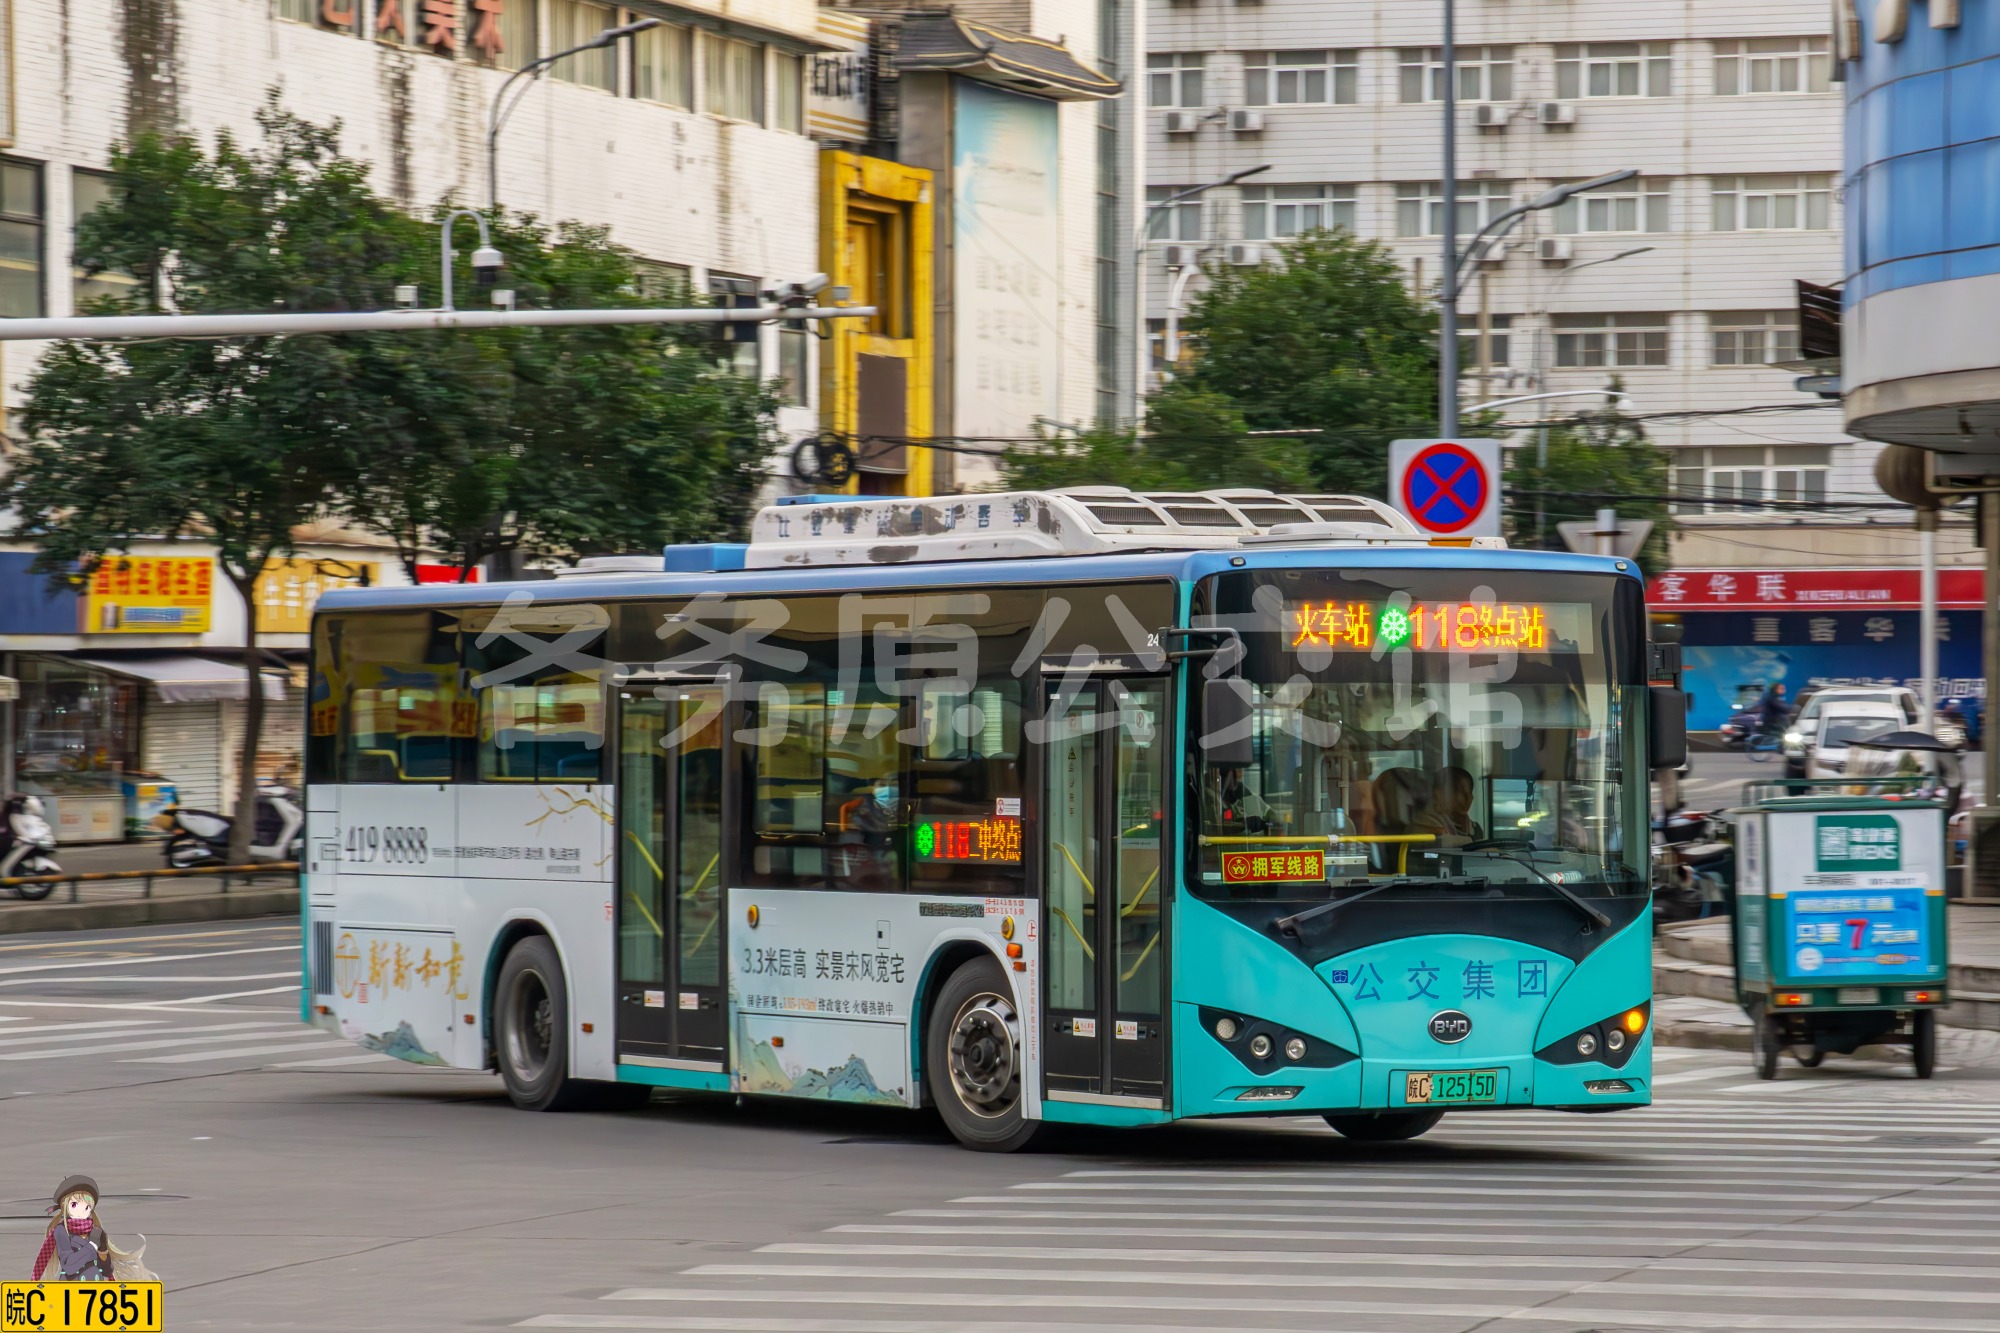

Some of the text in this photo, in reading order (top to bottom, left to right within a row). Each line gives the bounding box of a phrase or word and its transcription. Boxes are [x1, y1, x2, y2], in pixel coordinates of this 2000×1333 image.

[1292, 601, 1545, 649] 火车站 118 终点站
[345, 826, 428, 864] 419 8888
[933, 821, 970, 859] 118
[1252, 855, 1319, 878] 拥军线路
[742, 947, 905, 984] 3.3米层高 实景宋风宽宅
[1349, 959, 1548, 1001] 公交集团
[1433, 1019, 1468, 1034] BYD
[1437, 1075, 1495, 1098] 12515D
